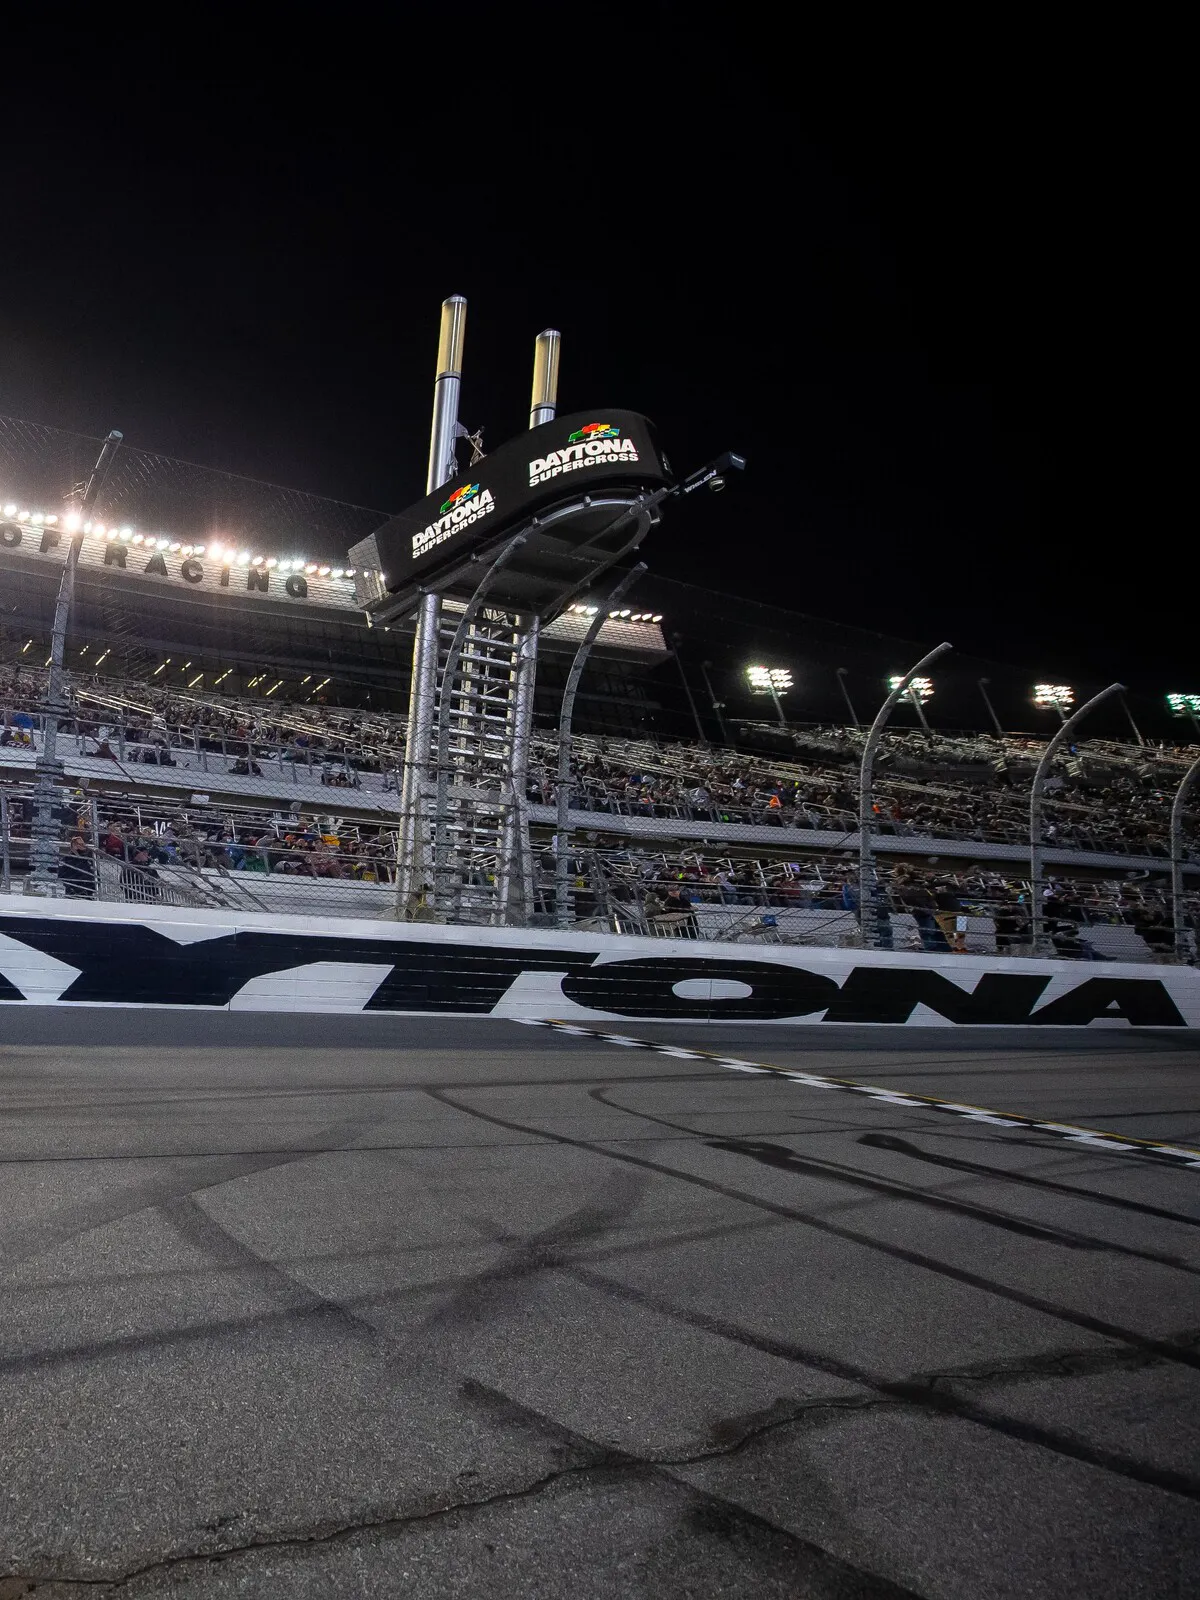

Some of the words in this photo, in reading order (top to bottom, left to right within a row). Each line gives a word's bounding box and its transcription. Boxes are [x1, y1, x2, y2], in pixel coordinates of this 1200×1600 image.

[529, 438, 636, 478] DAYTONA
[529, 453, 639, 487] SUPERCROSS
[412, 488, 493, 550] DAYTONA
[412, 502, 495, 559] SUPERCROSS
[104, 543, 308, 599] RACING
